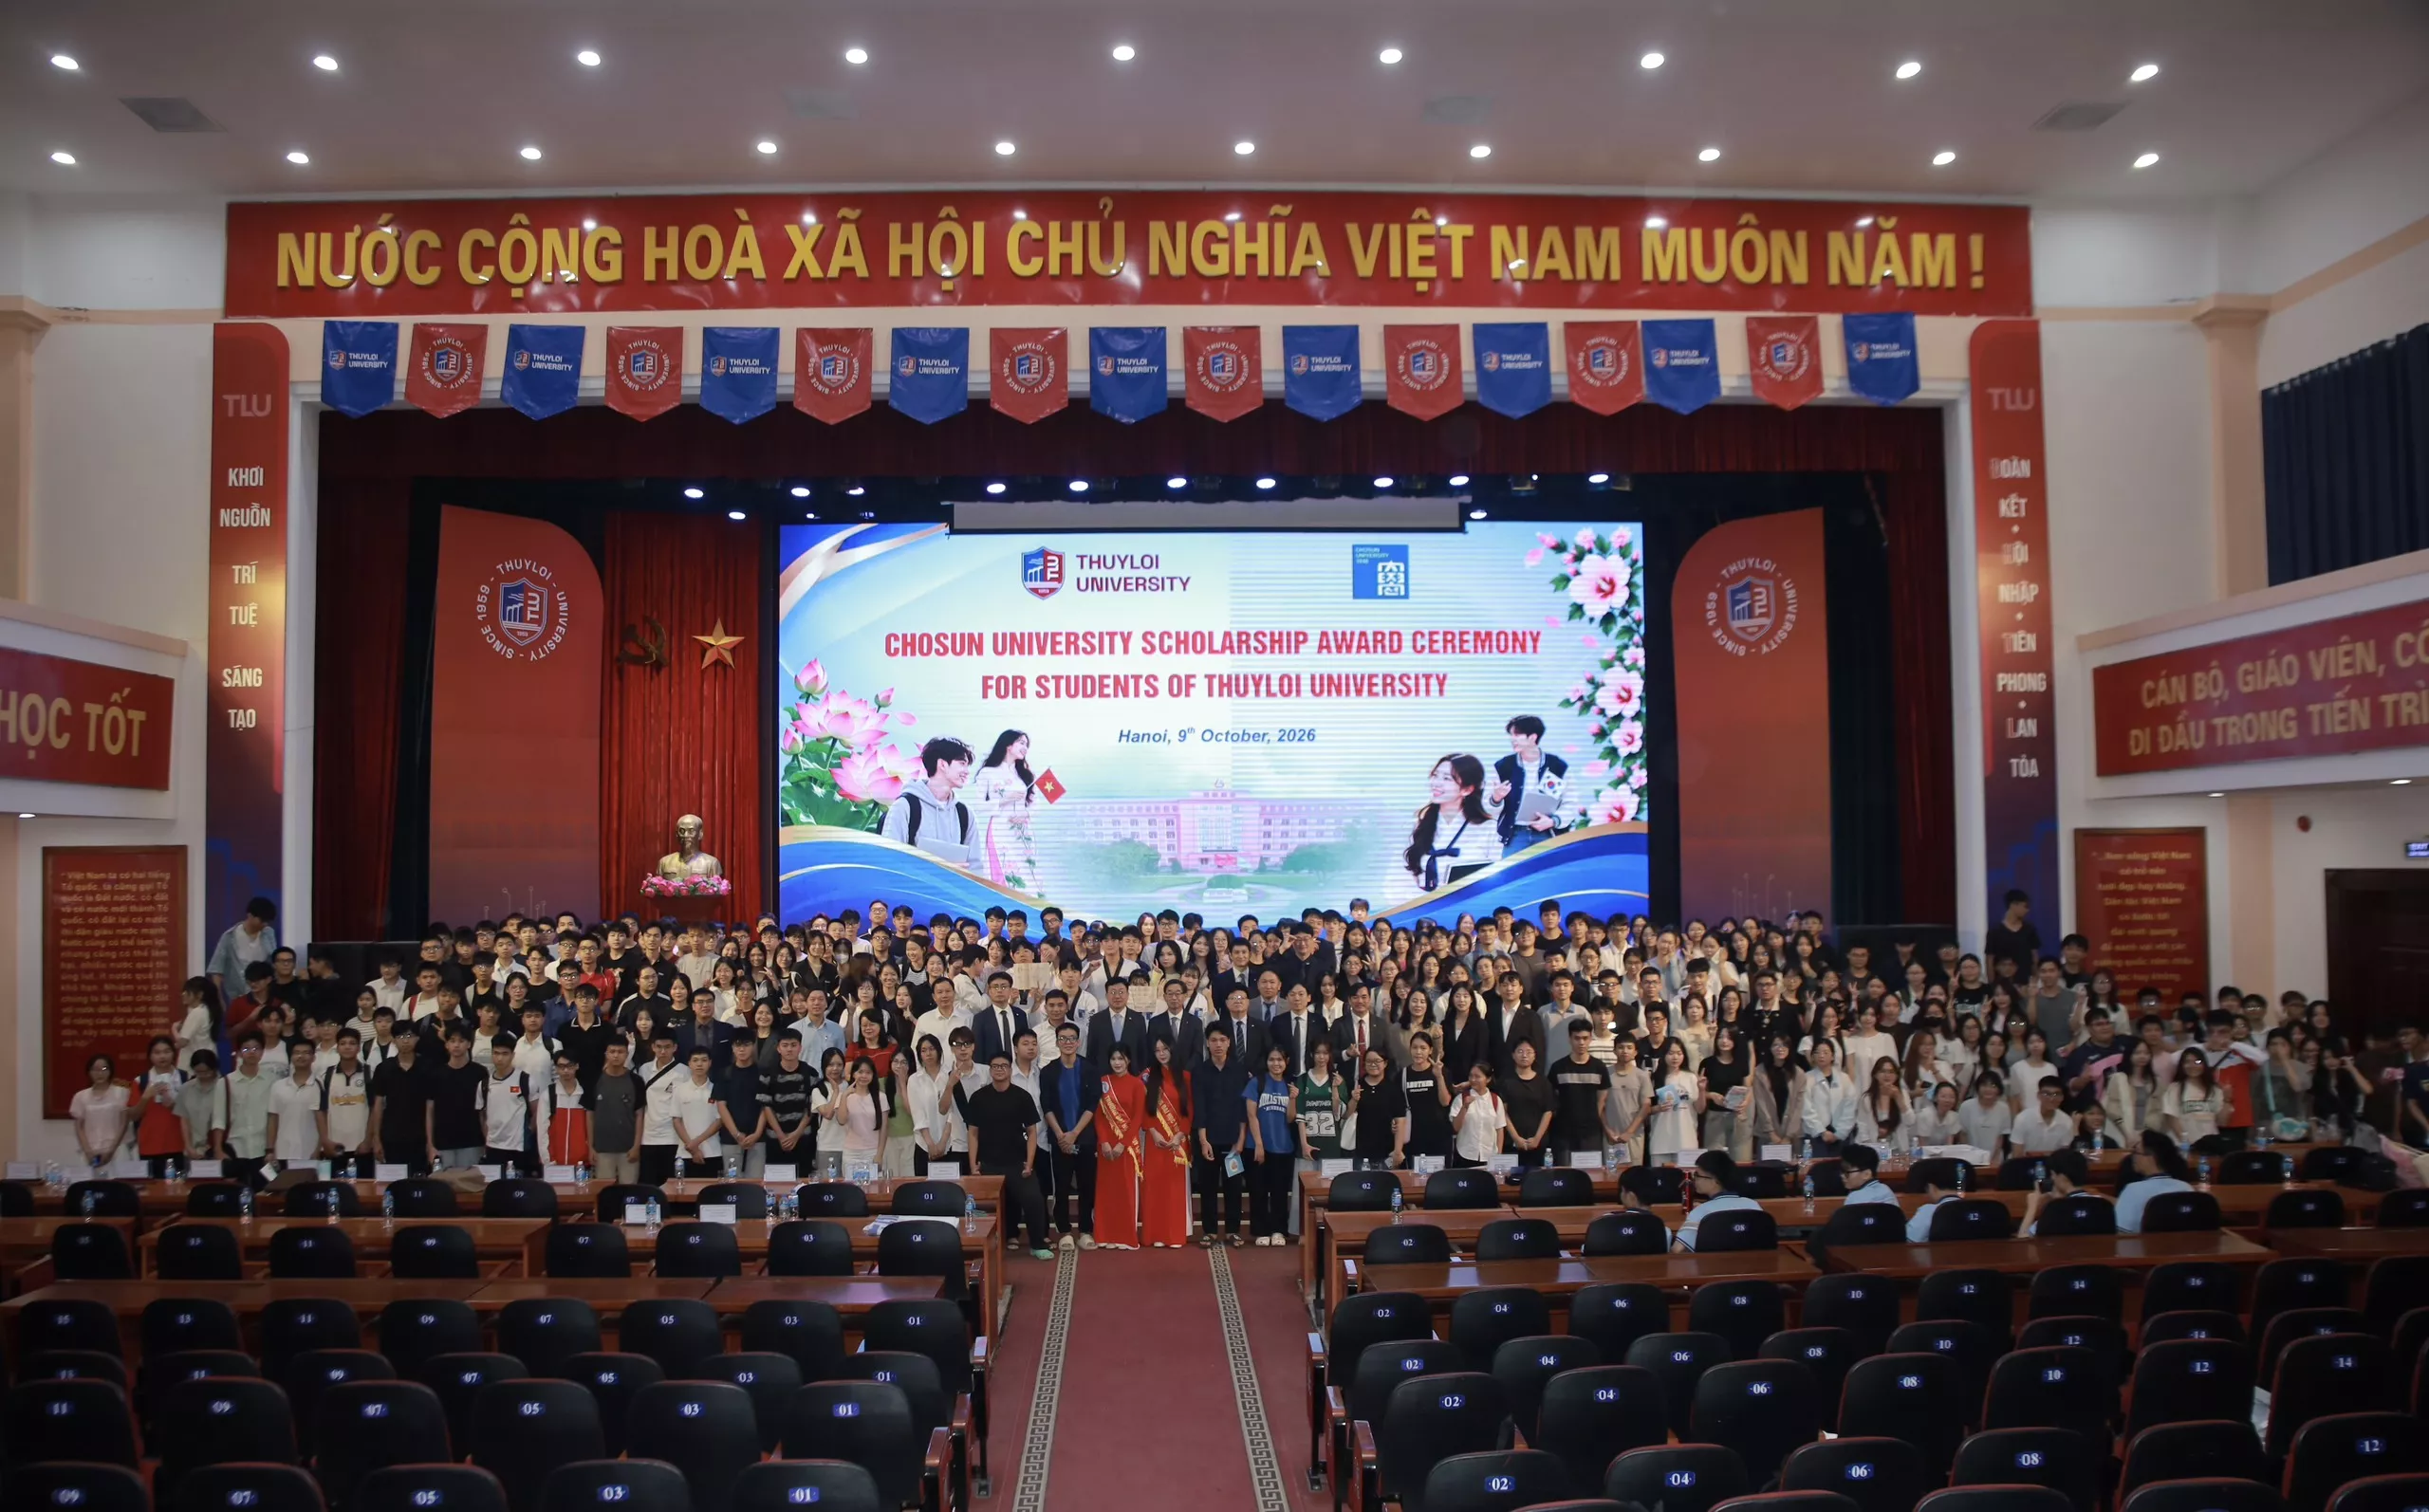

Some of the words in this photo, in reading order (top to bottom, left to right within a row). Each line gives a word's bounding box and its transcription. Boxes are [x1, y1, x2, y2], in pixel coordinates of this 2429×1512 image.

[276, 211, 442, 288] NƯỚC
[457, 213, 623, 298] CỘNG
[644, 207, 768, 281] HOÀ
[783, 208, 870, 279] XÃ
[888, 206, 987, 291] HỘI
[1006, 195, 1127, 277] CHỦ
[1147, 203, 1332, 279] NGHĨA
[1345, 208, 1475, 292] VIỆT
[1489, 225, 1622, 282] NAM
[1641, 212, 1809, 285] MUÔN
[432, 336, 464, 350] THUYLOI
[627, 340, 660, 351] THUYLOI
[818, 343, 850, 355] THUYLOI
[1011, 342, 1044, 354] THUYLOI
[348, 352, 379, 360] THUYLOI
[532, 353, 563, 362] THUYLOI
[729, 358, 760, 367] THUYLOI
[918, 358, 950, 367] THUYLOI
[1117, 358, 1148, 366] THUYLOI
[1310, 356, 1343, 364] THUYLOI
[348, 360, 389, 369] UNIVERSITY
[531, 361, 573, 372] UNIVERSITY
[729, 366, 771, 375] UNIVERSITY
[918, 366, 960, 375] UNIVERSITY
[1117, 365, 1159, 375] UNIVERSITY
[1310, 363, 1352, 373] UNIVERSITY
[222, 394, 272, 417] TLU
[1986, 388, 2035, 412] TLU
[228, 465, 265, 487] KHƠI
[1998, 492, 2028, 518] KẾT
[218, 502, 271, 527] NGUỒN
[1047, 555, 1060, 581] TLU
[1075, 554, 1159, 570] THUYLOI
[1720, 557, 1777, 580] THUYLOI
[232, 561, 258, 584] TRÍ
[496, 558, 552, 581] THUYLOI
[1076, 576, 1192, 592] UNIVERSITY
[1997, 581, 2039, 605] NHẬP
[476, 583, 491, 621] 1959
[527, 592, 541, 621] TLU
[1752, 586, 1769, 617] TLU
[230, 602, 258, 628] TUỆ
[1760, 579, 1798, 655] UNIVERSITY
[529, 591, 569, 662] UNIVERSITY
[480, 623, 515, 659] SINCE
[884, 632, 985, 657] CHOSUN
[992, 631, 1134, 656] UNIVERSITY
[1140, 630, 1309, 655] SCHOLARSHIP
[1316, 630, 1403, 655] AWARD
[1411, 630, 1543, 655] CEREMONY
[1712, 628, 1746, 656] SINCE
[222, 664, 264, 688] SÁNG
[2141, 669, 2188, 710] CÁN
[2237, 650, 2301, 694] GIÁO
[2308, 635, 2386, 681] VIÊN,
[981, 674, 1027, 699] FOR
[1035, 674, 1159, 699] STUDENTS
[1168, 673, 1196, 698] OF
[1207, 673, 1302, 698] THUYLOI
[1309, 673, 1449, 698] UNIVERSITY
[1996, 673, 2047, 692] PHONG
[0, 689, 72, 760] HỌC
[83, 687, 148, 757] TỐT
[228, 709, 256, 731] TẠO
[2128, 727, 2152, 757] ĐI
[2213, 707, 2298, 747] TRONG
[2306, 684, 2372, 735] TIẾN
[2006, 718, 2037, 739] LAN
[1118, 728, 1172, 745] Hanoi,
[1177, 726, 1196, 743] 9th
[1200, 728, 1272, 745] October,
[1277, 728, 1317, 743] 2026
[2009, 753, 2039, 778] TỎA
[1305, 1111, 1336, 1137] 32
[578, 1236, 589, 1245] 07
[803, 1234, 814, 1243] 03
[1402, 1238, 1414, 1246] 02
[539, 1314, 552, 1324] 07
[1377, 1308, 1390, 1318] 02
[785, 1316, 798, 1325] 03
[908, 1316, 920, 1326] 01
[1541, 1355, 1555, 1366] 04
[1673, 1352, 1691, 1361] 06
[1405, 1359, 1419, 1370] 02
[2195, 1361, 2210, 1373] 12
[329, 1369, 344, 1380] 09
[462, 1372, 478, 1383] 07
[599, 1373, 615, 1383] 05
[877, 1371, 891, 1382] 01
[2048, 1369, 2064, 1381] 10
[1902, 1375, 1918, 1388] 08
[1596, 1389, 1614, 1401] 04
[1752, 1383, 1768, 1394] 06
[212, 1400, 232, 1413] 09
[522, 1402, 540, 1415] 05
[1444, 1396, 1460, 1408] 02
[364, 1403, 382, 1416] 07
[683, 1403, 699, 1416] 03
[838, 1403, 853, 1416] 01
[2364, 1439, 2380, 1452] 12
[2018, 1452, 2040, 1466] 08
[1851, 1465, 1868, 1478] 06
[1492, 1477, 1509, 1491] 02
[1671, 1472, 1690, 1485] 04
[231, 1490, 251, 1505] 07
[415, 1490, 436, 1505] 05
[603, 1485, 625, 1501] 03
[794, 1487, 812, 1503] 01
